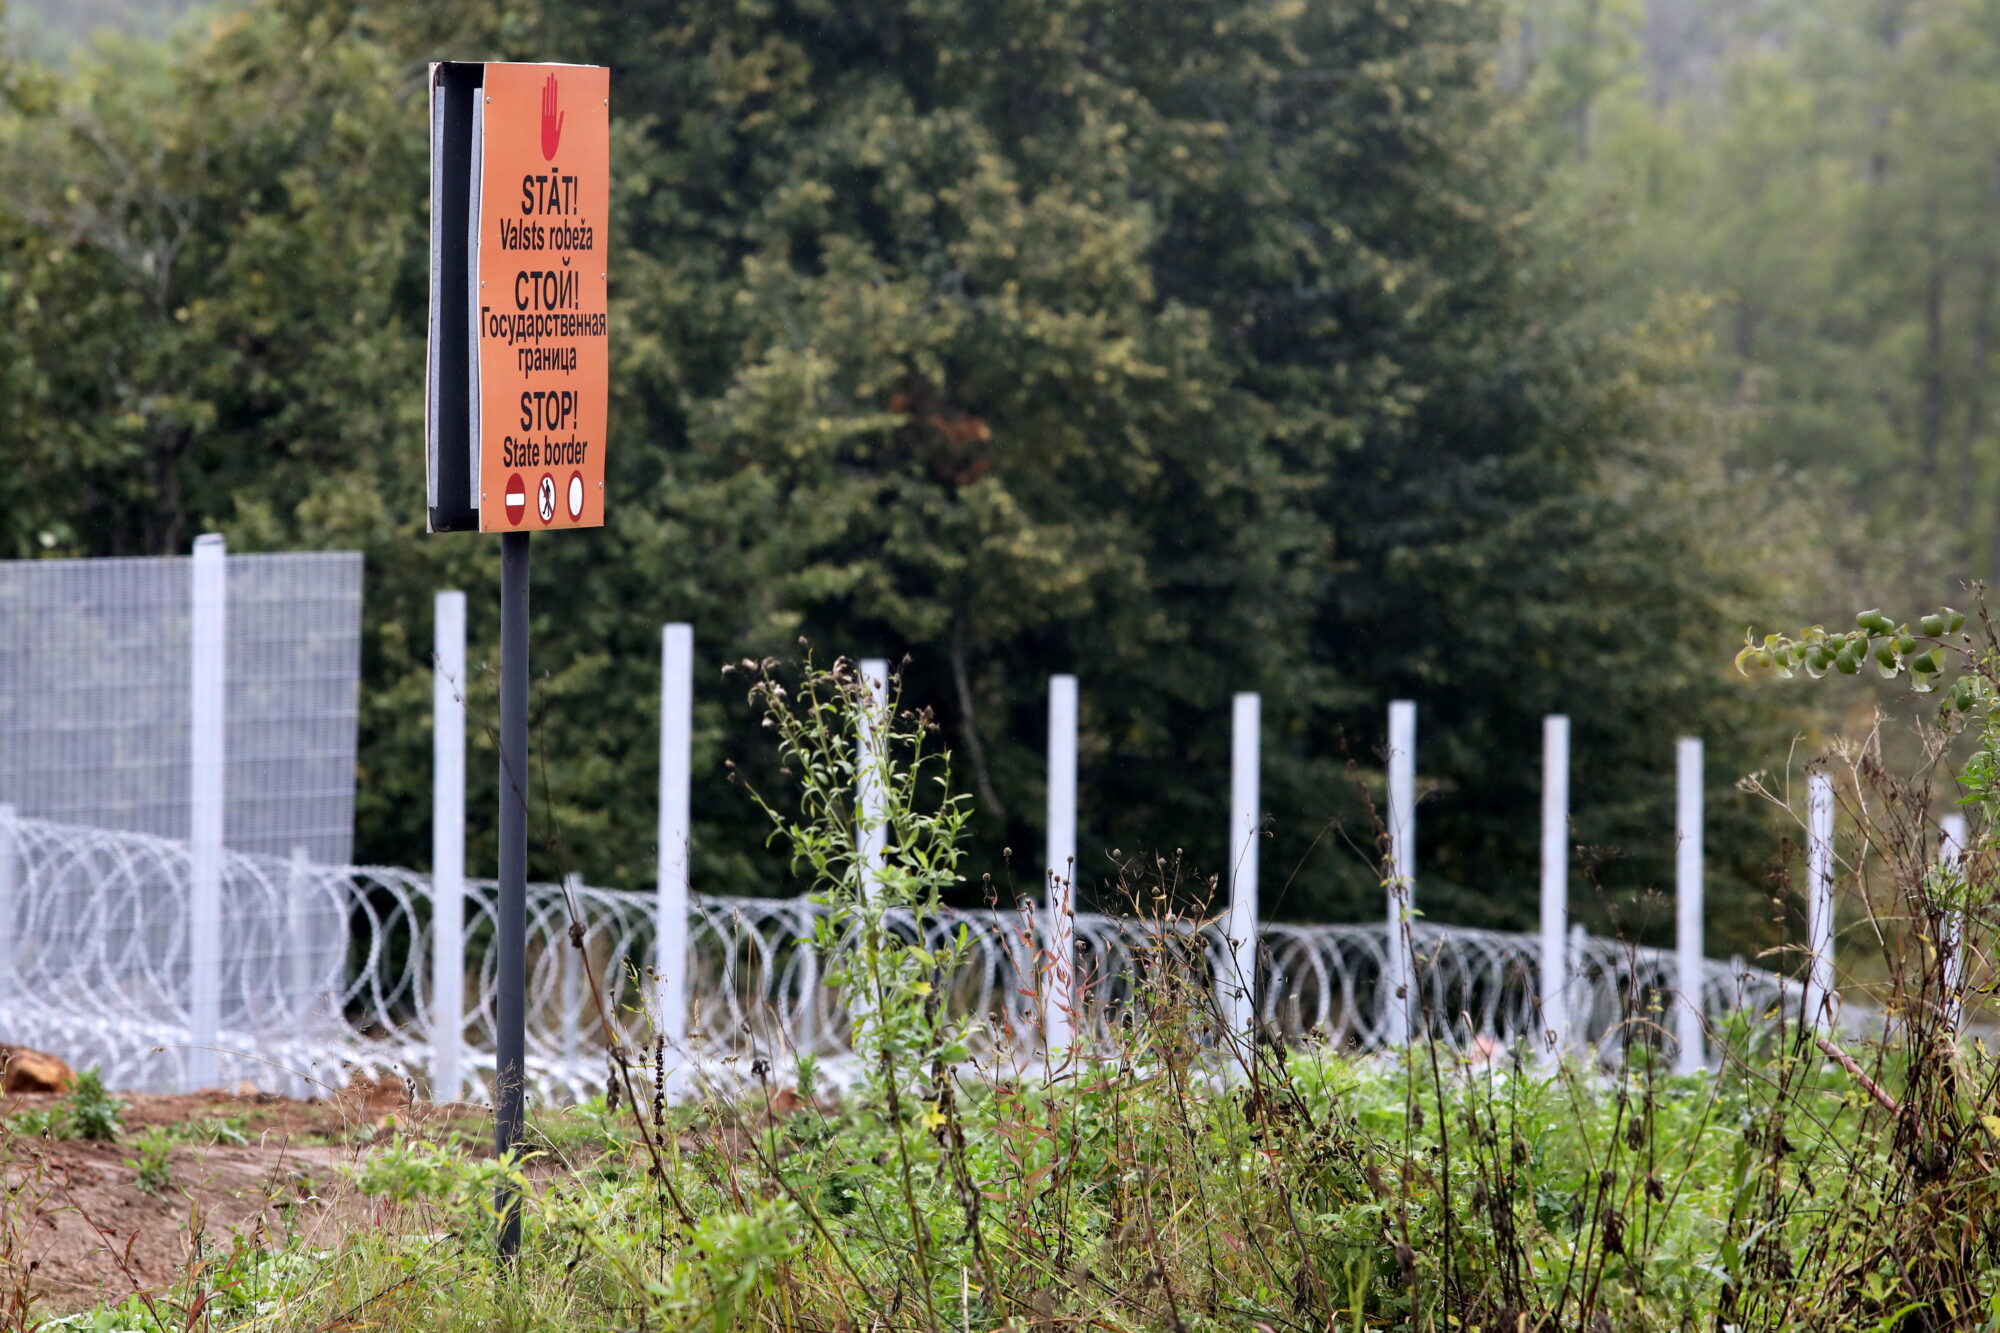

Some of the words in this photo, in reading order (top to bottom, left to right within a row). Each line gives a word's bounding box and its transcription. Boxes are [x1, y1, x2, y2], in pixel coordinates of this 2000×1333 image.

[521, 167, 578, 215] STĀT!
[500, 218, 545, 250] Valsts
[550, 218, 593, 250] robeža
[515, 256, 579, 311] СТОЙ!
[482, 306, 606, 346] Государственная
[518, 347, 577, 379] граница
[520, 391, 578, 432] STOP!
[503, 436, 539, 467] State
[544, 434, 587, 466] border
